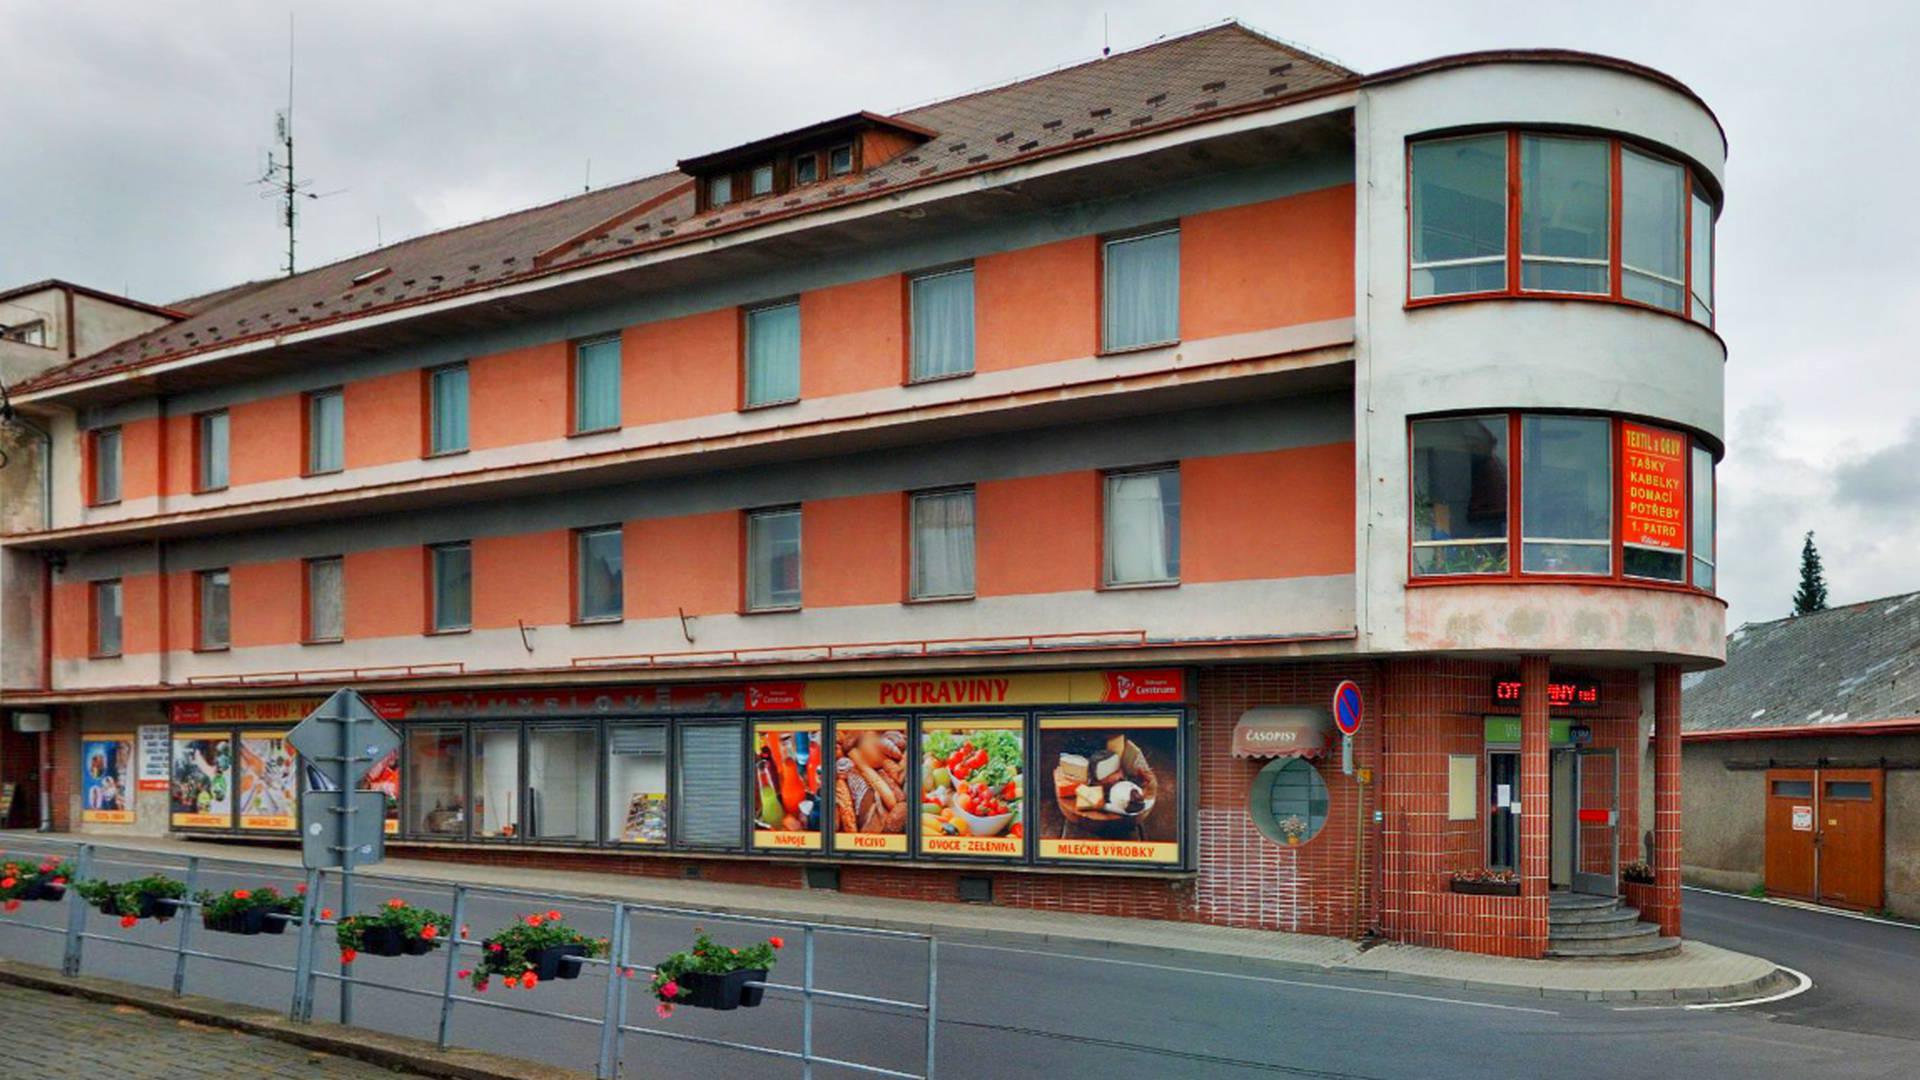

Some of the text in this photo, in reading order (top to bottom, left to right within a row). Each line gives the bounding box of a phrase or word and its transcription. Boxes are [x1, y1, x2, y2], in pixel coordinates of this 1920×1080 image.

[1626, 430, 1652, 451] TEXTIL
[1630, 456, 1665, 473] TAŠKY
[1631, 471, 1679, 489] KABELKY
[1631, 502, 1680, 519] POTŘEBY
[1631, 521, 1677, 537] 1. PATRO
[880, 679, 1009, 704] POTRAVINY
[1136, 686, 1177, 695] Centrum
[210, 703, 249, 720] TEXTIL
[256, 702, 289, 719] OBUV
[1246, 729, 1297, 741] ČASOPISY
[929, 840, 960, 850] OVOCE
[968, 841, 1016, 853] ZELENINA
